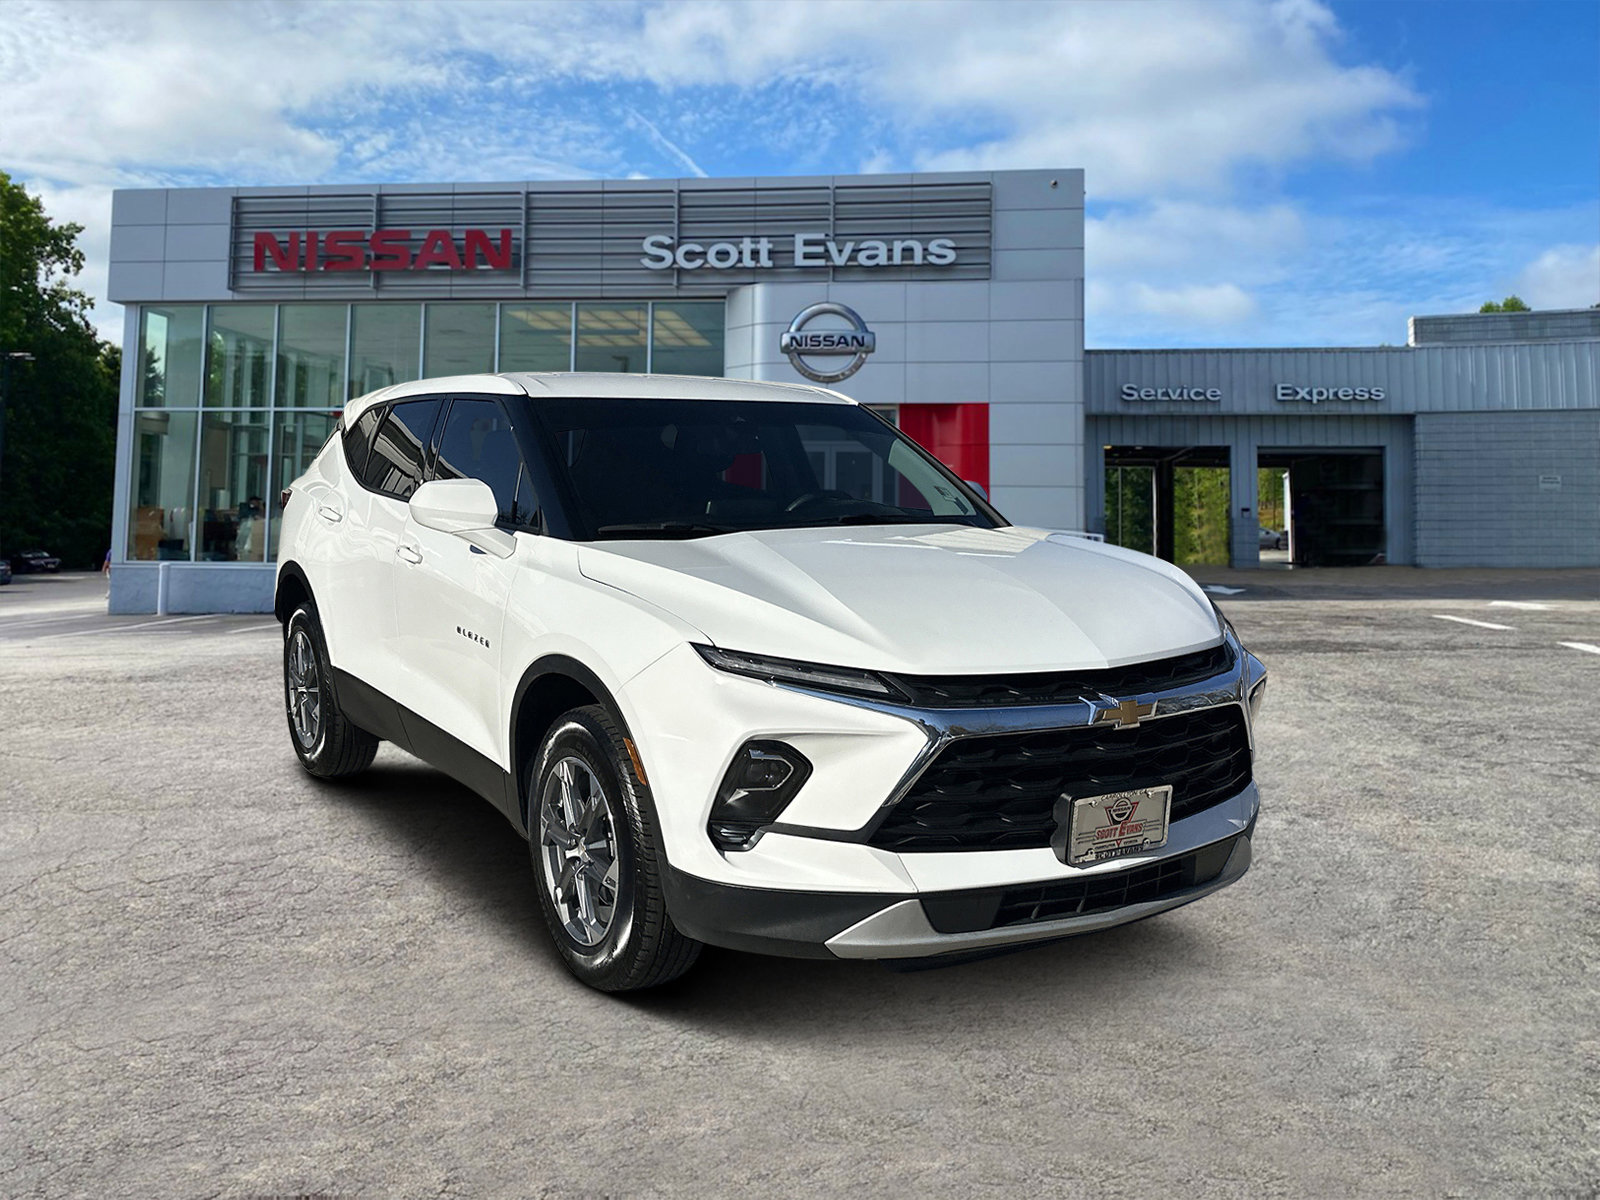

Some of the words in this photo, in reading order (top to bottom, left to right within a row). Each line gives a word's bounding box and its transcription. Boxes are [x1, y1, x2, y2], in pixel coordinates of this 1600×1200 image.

[254, 229, 512, 272] NISSAN
[640, 234, 773, 269] Scott
[794, 233, 957, 267] Evans
[790, 335, 865, 348] NISSAN
[1121, 383, 1222, 401] Service
[1275, 383, 1386, 404] Express
[456, 625, 490, 649] BLAZER
[1096, 827, 1118, 840] SCOTT
[1118, 821, 1143, 836] EVANS
